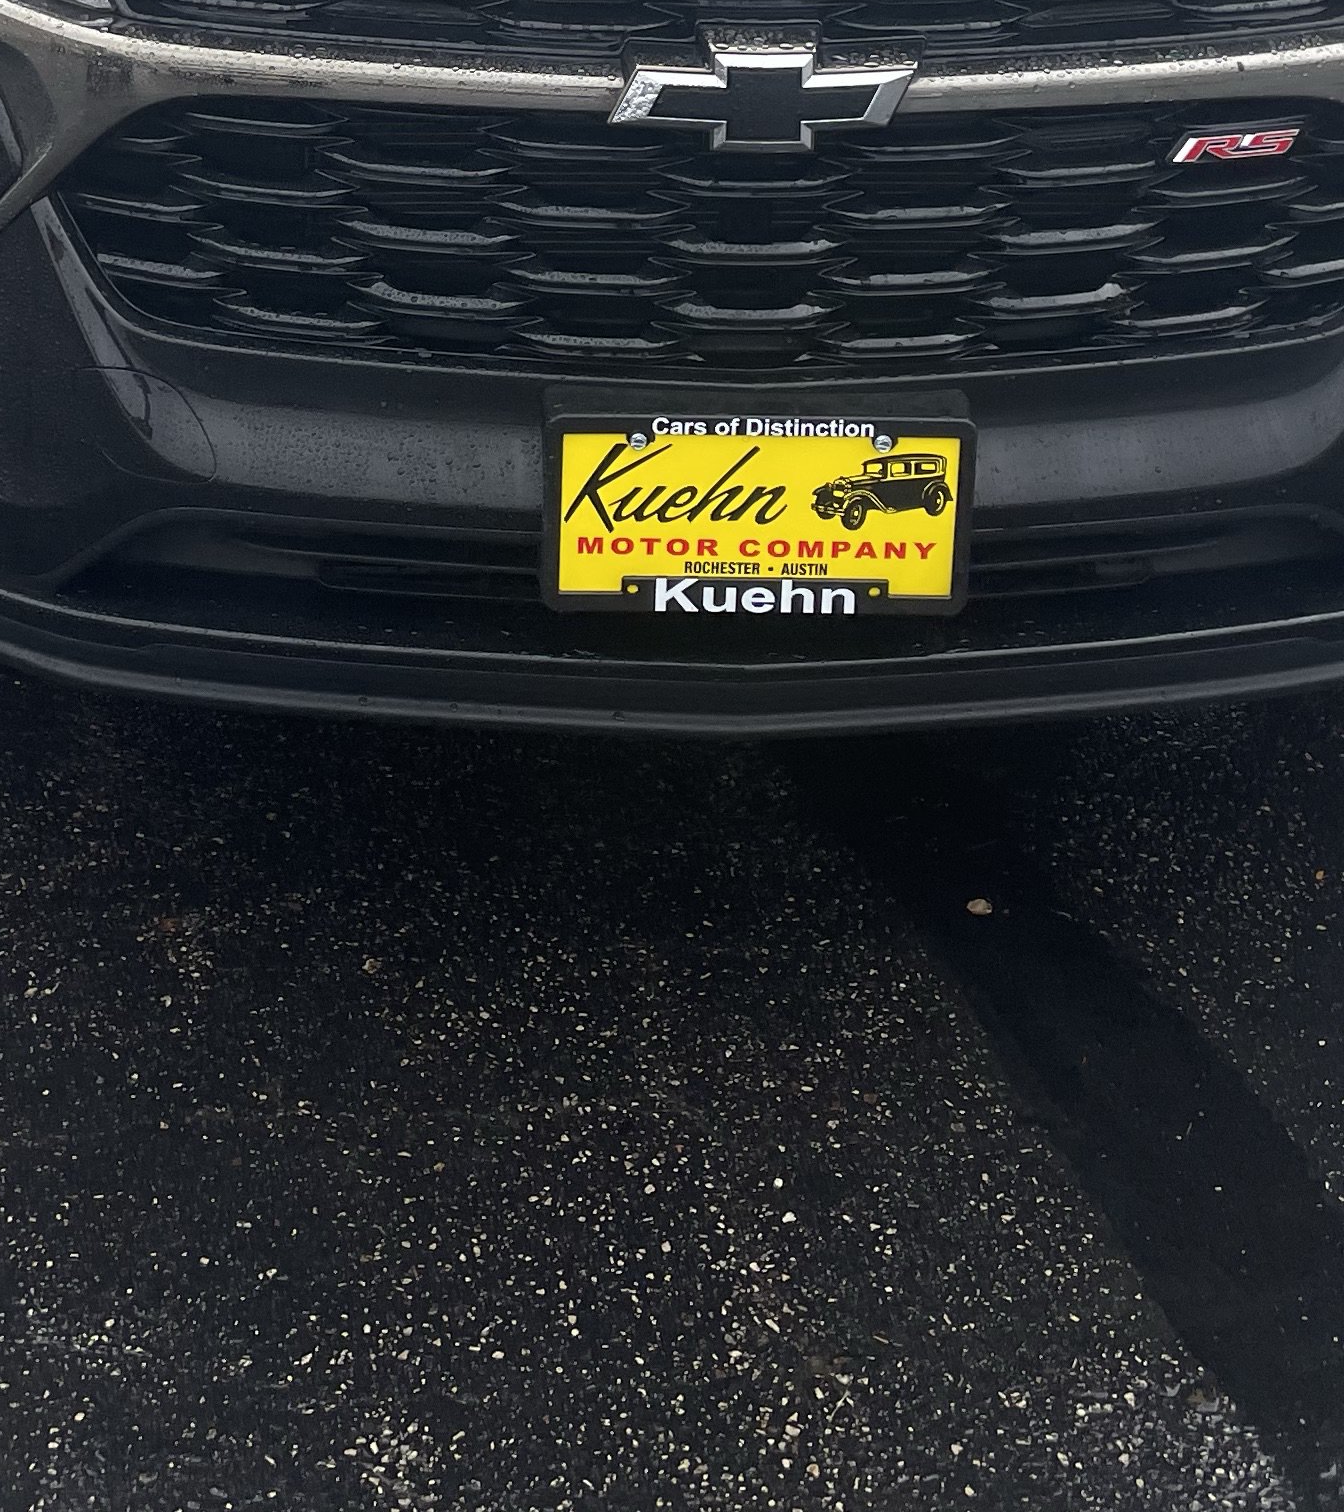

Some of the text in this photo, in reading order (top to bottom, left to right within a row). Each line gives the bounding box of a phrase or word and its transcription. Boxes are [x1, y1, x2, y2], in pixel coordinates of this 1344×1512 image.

[1172, 128, 1300, 163] RS
[651, 417, 875, 438] Cars of Distinction
[563, 443, 788, 534] Kuehn
[577, 536, 937, 560] MOTOR COMPANY
[684, 561, 828, 576] ROCHESTER AUSTIN
[655, 577, 856, 615] Kuehn
